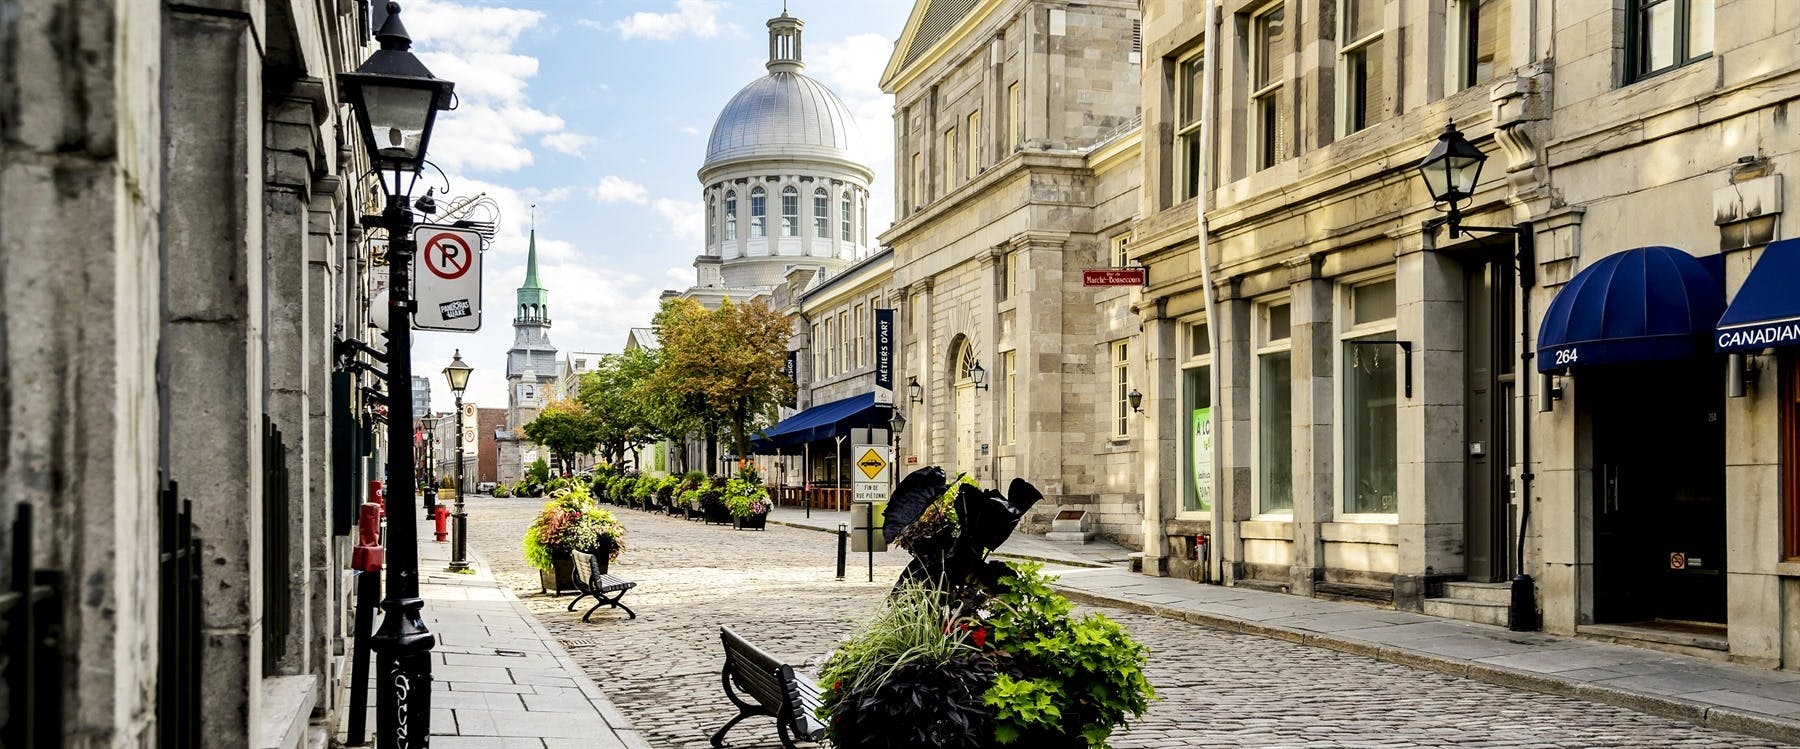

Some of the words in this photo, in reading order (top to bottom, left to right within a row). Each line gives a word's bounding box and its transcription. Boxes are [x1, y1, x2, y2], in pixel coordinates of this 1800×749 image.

[1718, 324, 1800, 348] CANADIAN
[879, 344, 889, 382] MÉTIERS
[1555, 347, 1578, 365] 264
